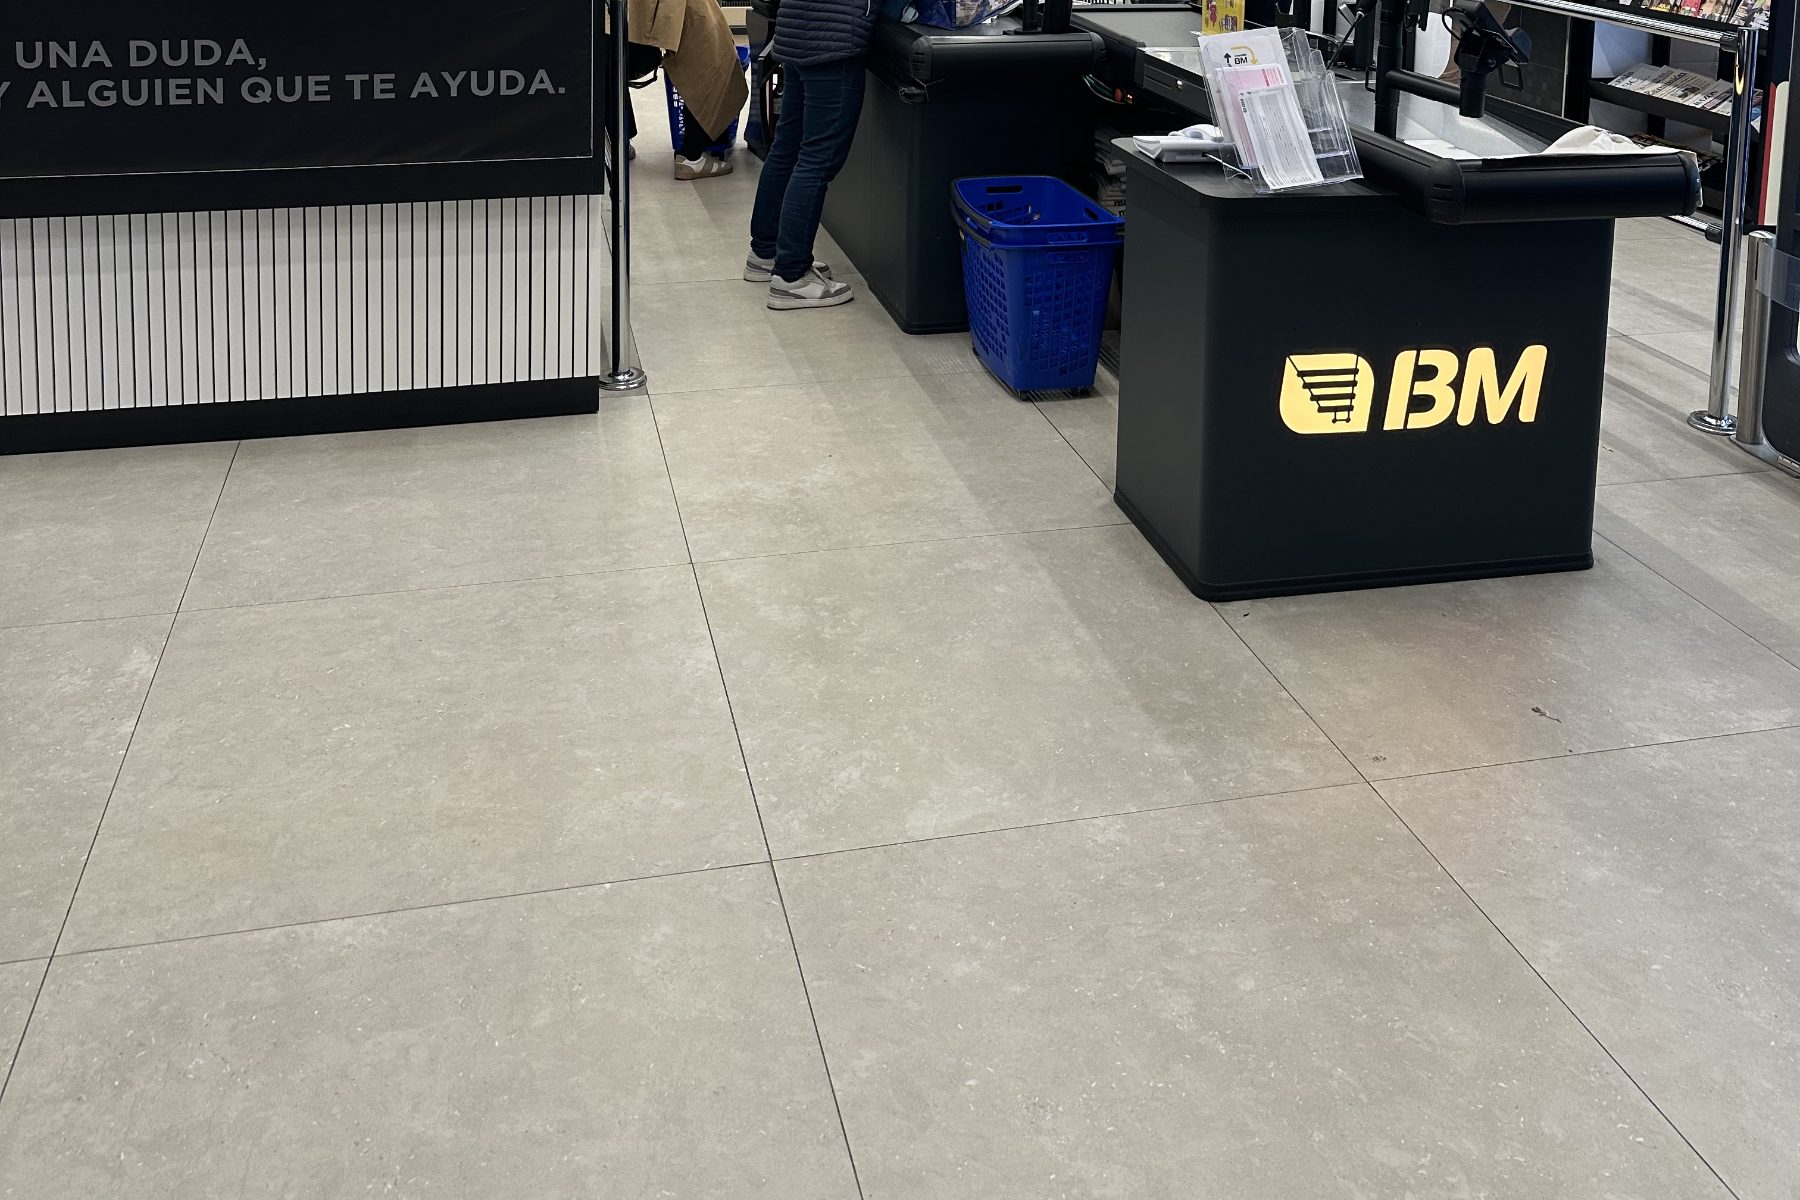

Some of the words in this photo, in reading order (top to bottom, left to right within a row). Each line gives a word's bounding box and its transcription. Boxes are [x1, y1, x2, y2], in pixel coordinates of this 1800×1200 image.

[15, 39, 114, 70] UNA
[129, 38, 268, 71] DUDA,
[1234, 56, 1248, 65] BM
[26, 77, 225, 109] ALGUIEN
[240, 75, 332, 104] QUE
[345, 73, 396, 100] TE
[409, 68, 566, 98] AYUDA.
[1382, 344, 1548, 432] BM
